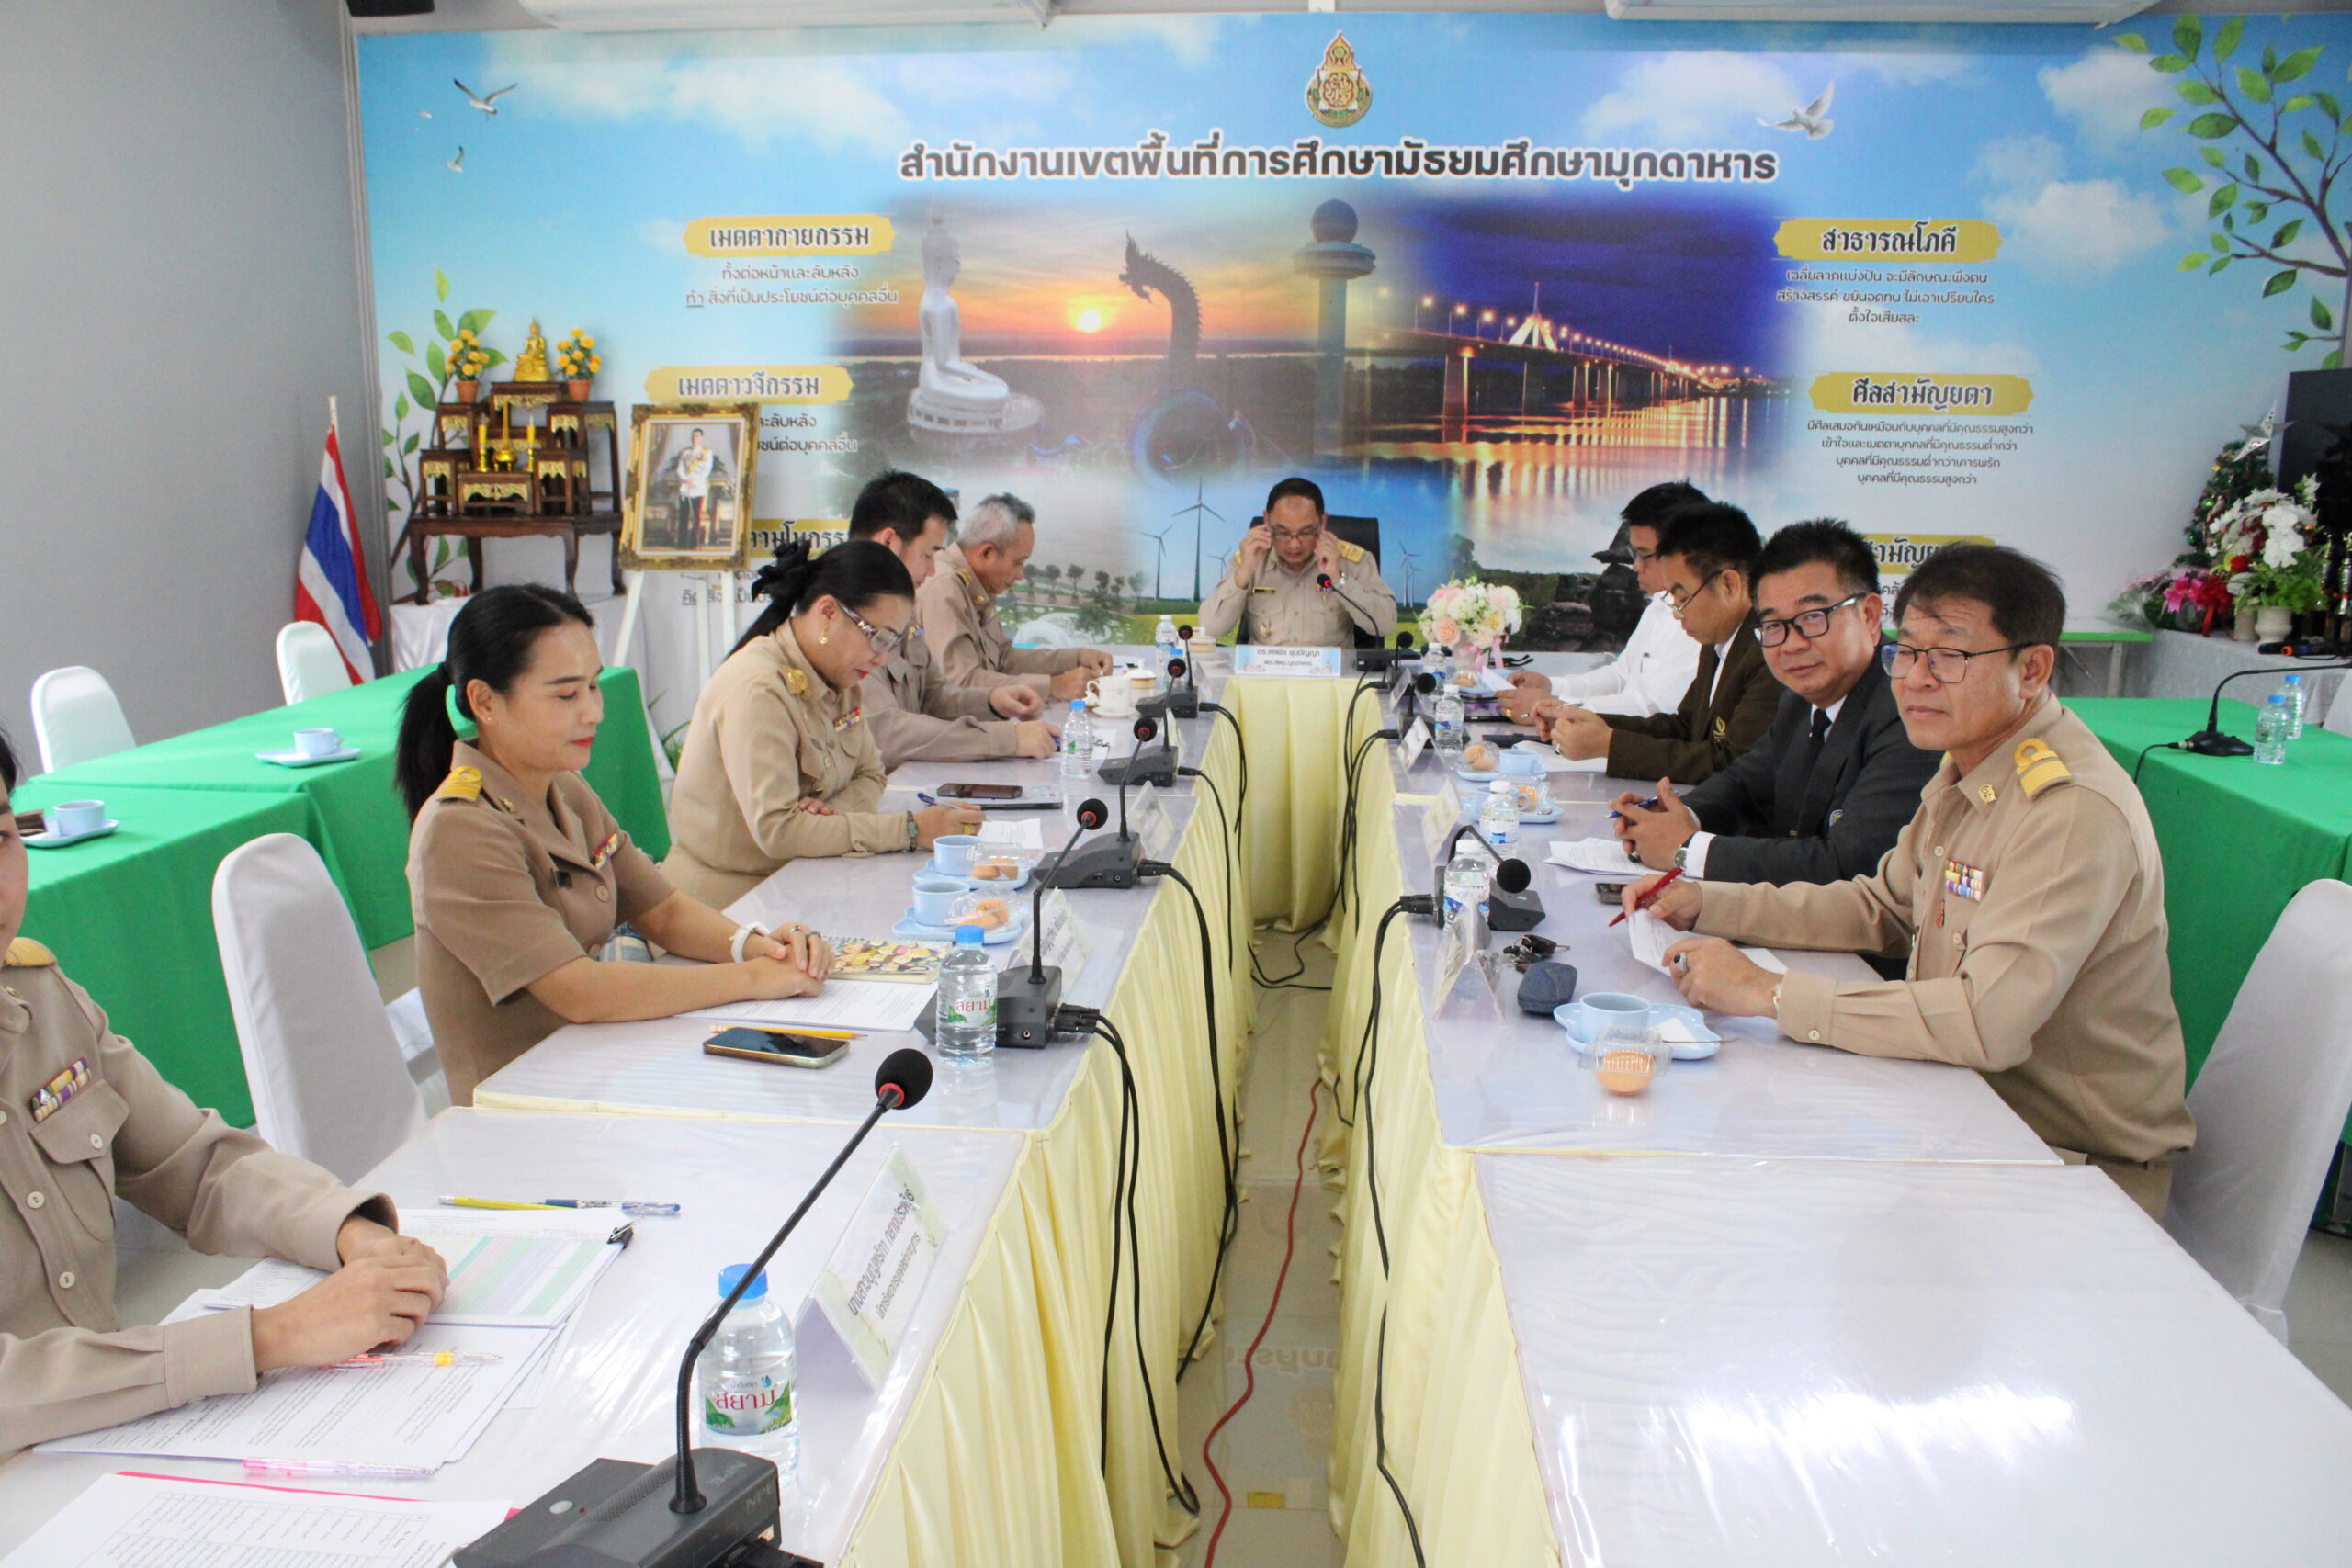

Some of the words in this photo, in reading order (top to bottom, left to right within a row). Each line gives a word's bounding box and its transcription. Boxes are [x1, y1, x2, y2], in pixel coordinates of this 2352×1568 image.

[899, 131, 1778, 187] สำนักงานเขตพื้นที่การศึกษามัธยมศึกษามุกดาหาร
[710, 226, 869, 248] เมตตากายกรรม
[1822, 220, 1958, 253] สาธารณโภคี
[722, 262, 859, 279] ทั้งต่อหน้าและลับหลัง
[686, 288, 705, 304] ทำ
[708, 283, 898, 307] สิ่งที่เป็นประโยชน์ต่อบุคคลอื่น
[1777, 288, 1838, 301] สร้างสรรค์
[1905, 289, 1995, 304] ไม่เอาเปรียบใคร
[1849, 306, 1920, 323] ตั้งใจเสียสละ
[678, 370, 820, 396] เมตตาวจีกรรม
[1852, 377, 1993, 411] ศีลสามัญยตา
[1857, 469, 1977, 487] บุคคลที่มีคุณธรรมสูงกว่า
[956, 998, 991, 1012] สยาม
[716, 1388, 775, 1411] สยาม
